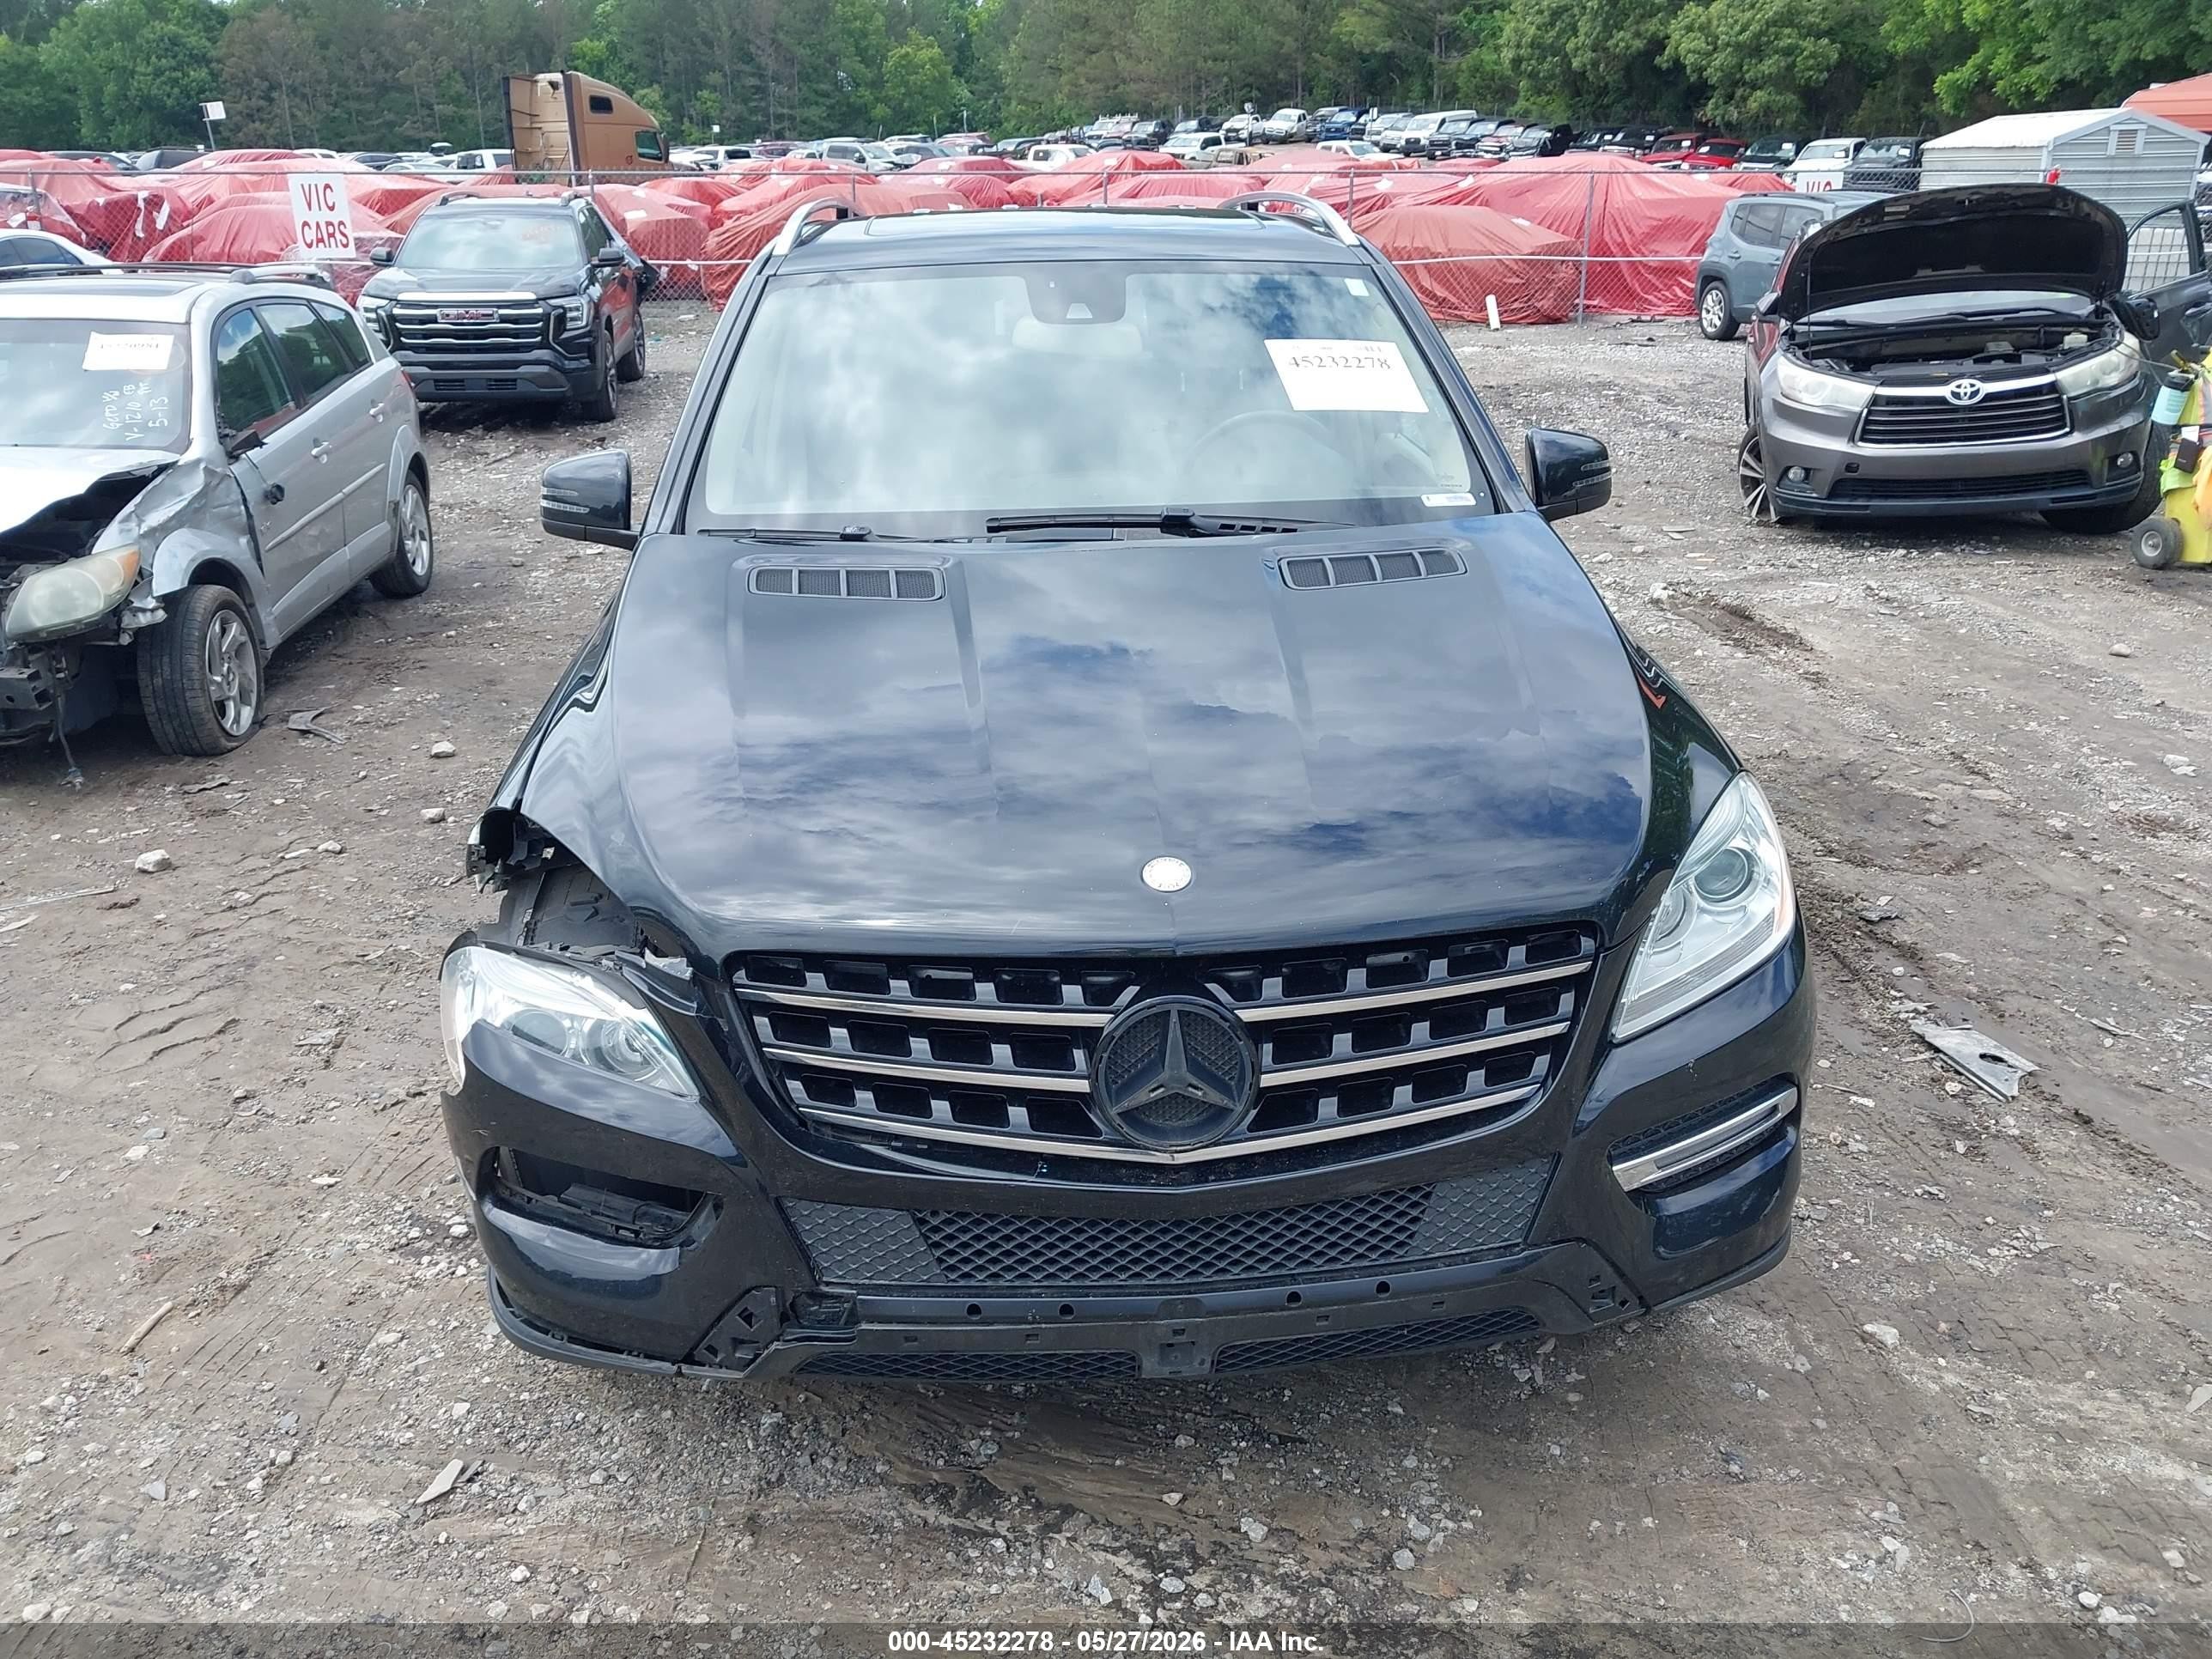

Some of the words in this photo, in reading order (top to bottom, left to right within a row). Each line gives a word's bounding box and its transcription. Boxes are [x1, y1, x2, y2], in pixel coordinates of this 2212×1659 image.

[301, 183, 336, 211] VIC
[301, 220, 349, 248] CARS
[441, 310, 495, 320] GMC
[1289, 356, 1391, 369] 45232278
[148, 396, 168, 428] 5-13
